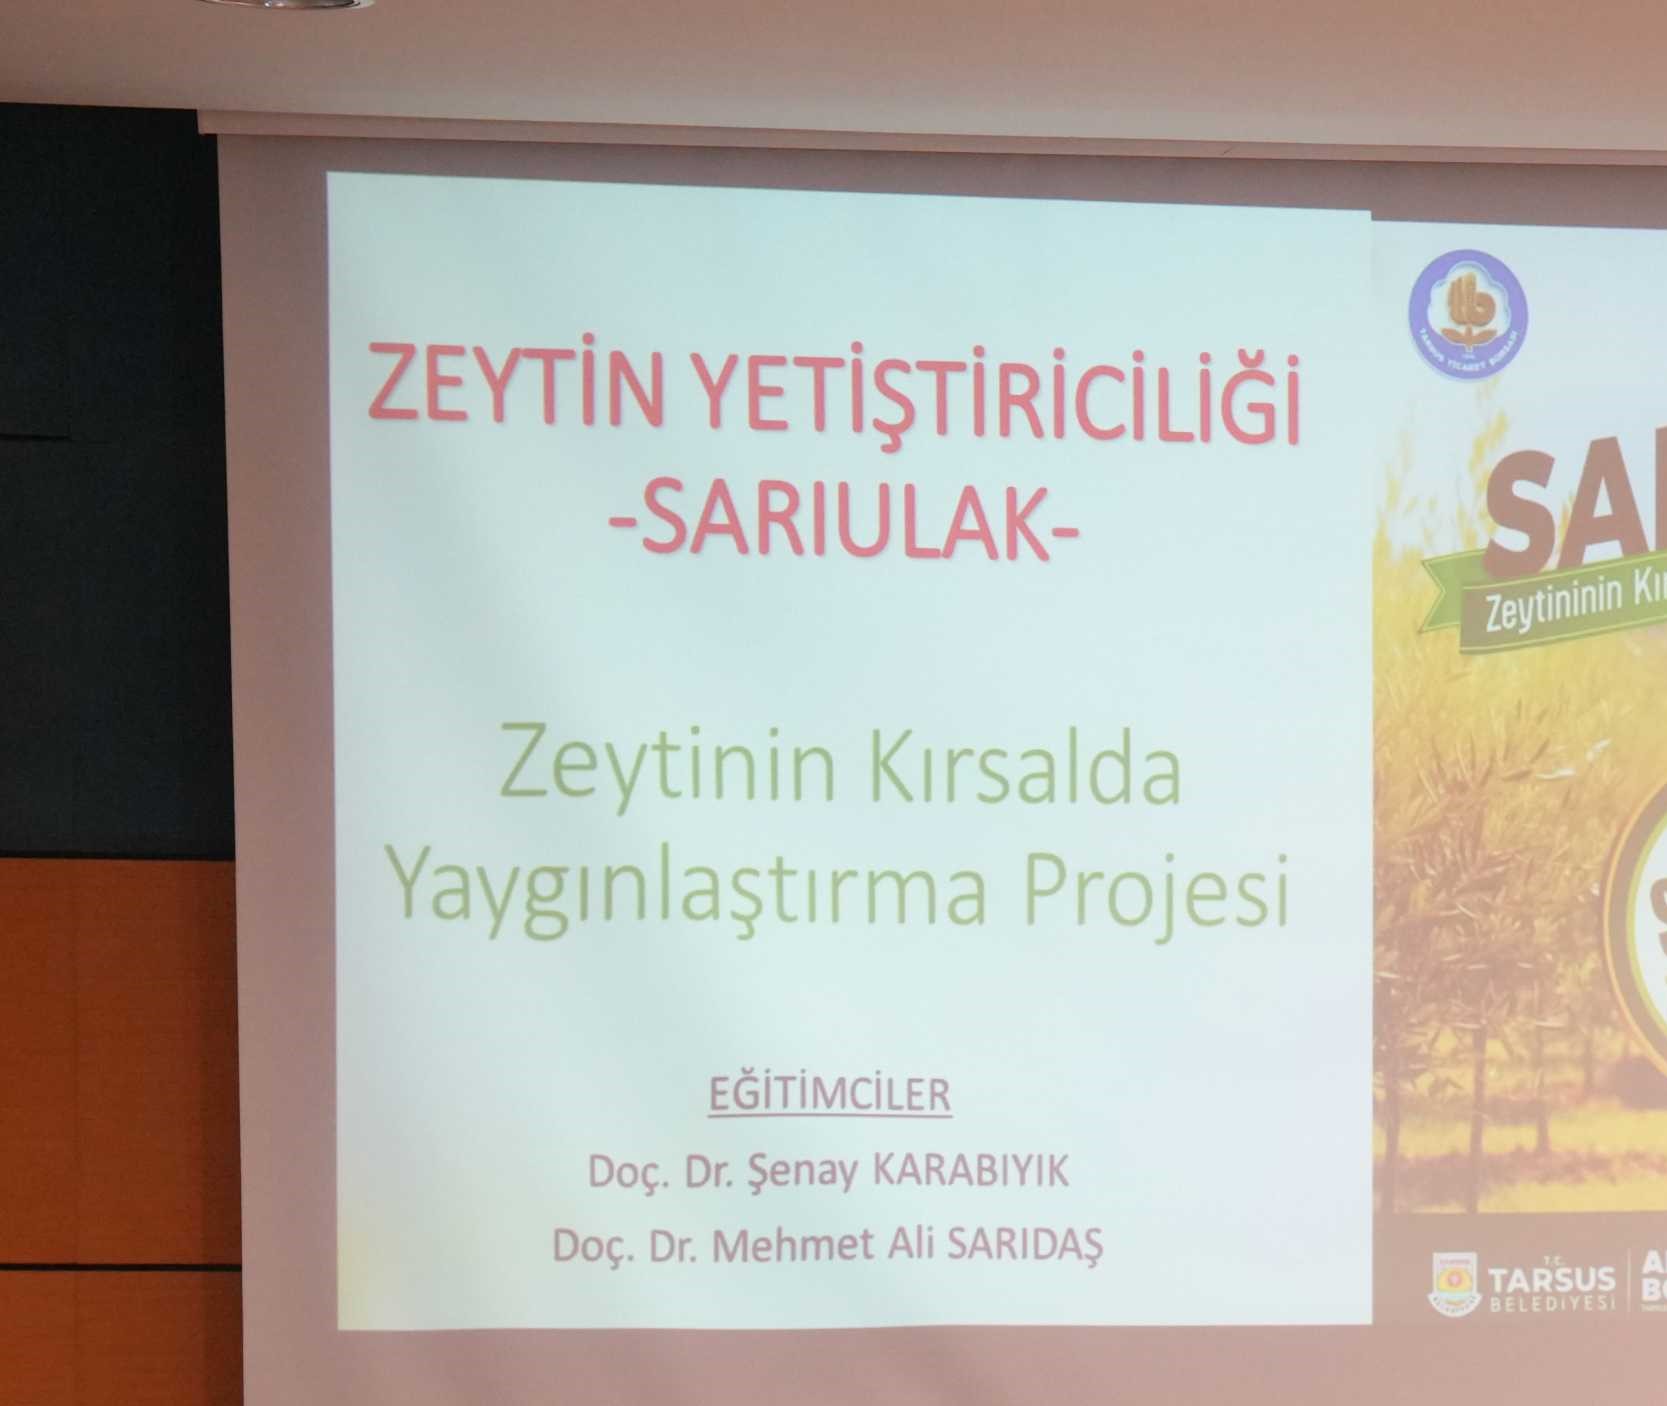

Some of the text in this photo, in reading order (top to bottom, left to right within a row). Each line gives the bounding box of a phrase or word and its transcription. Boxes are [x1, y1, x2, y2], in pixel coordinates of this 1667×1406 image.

[369, 332, 1301, 454] ZEYTİN YETİŞTİRİCİLİĞİ
[608, 476, 1081, 563] -SARIULAK-
[1486, 575, 1622, 634] Zeytininin
[499, 722, 1181, 817] Zeytinin Kırsalda
[384, 841, 1289, 946] Yaygınlaştırma Projesi
[707, 1067, 954, 1114] EĞİTİMCİLER
[589, 1152, 1071, 1196] Doç. Dr. Şenay KARABIYIK
[554, 1224, 1105, 1273] Doç. Dr. Mehmet Ali SARIDAŞ
[1488, 1266, 1617, 1293] TARSUS
